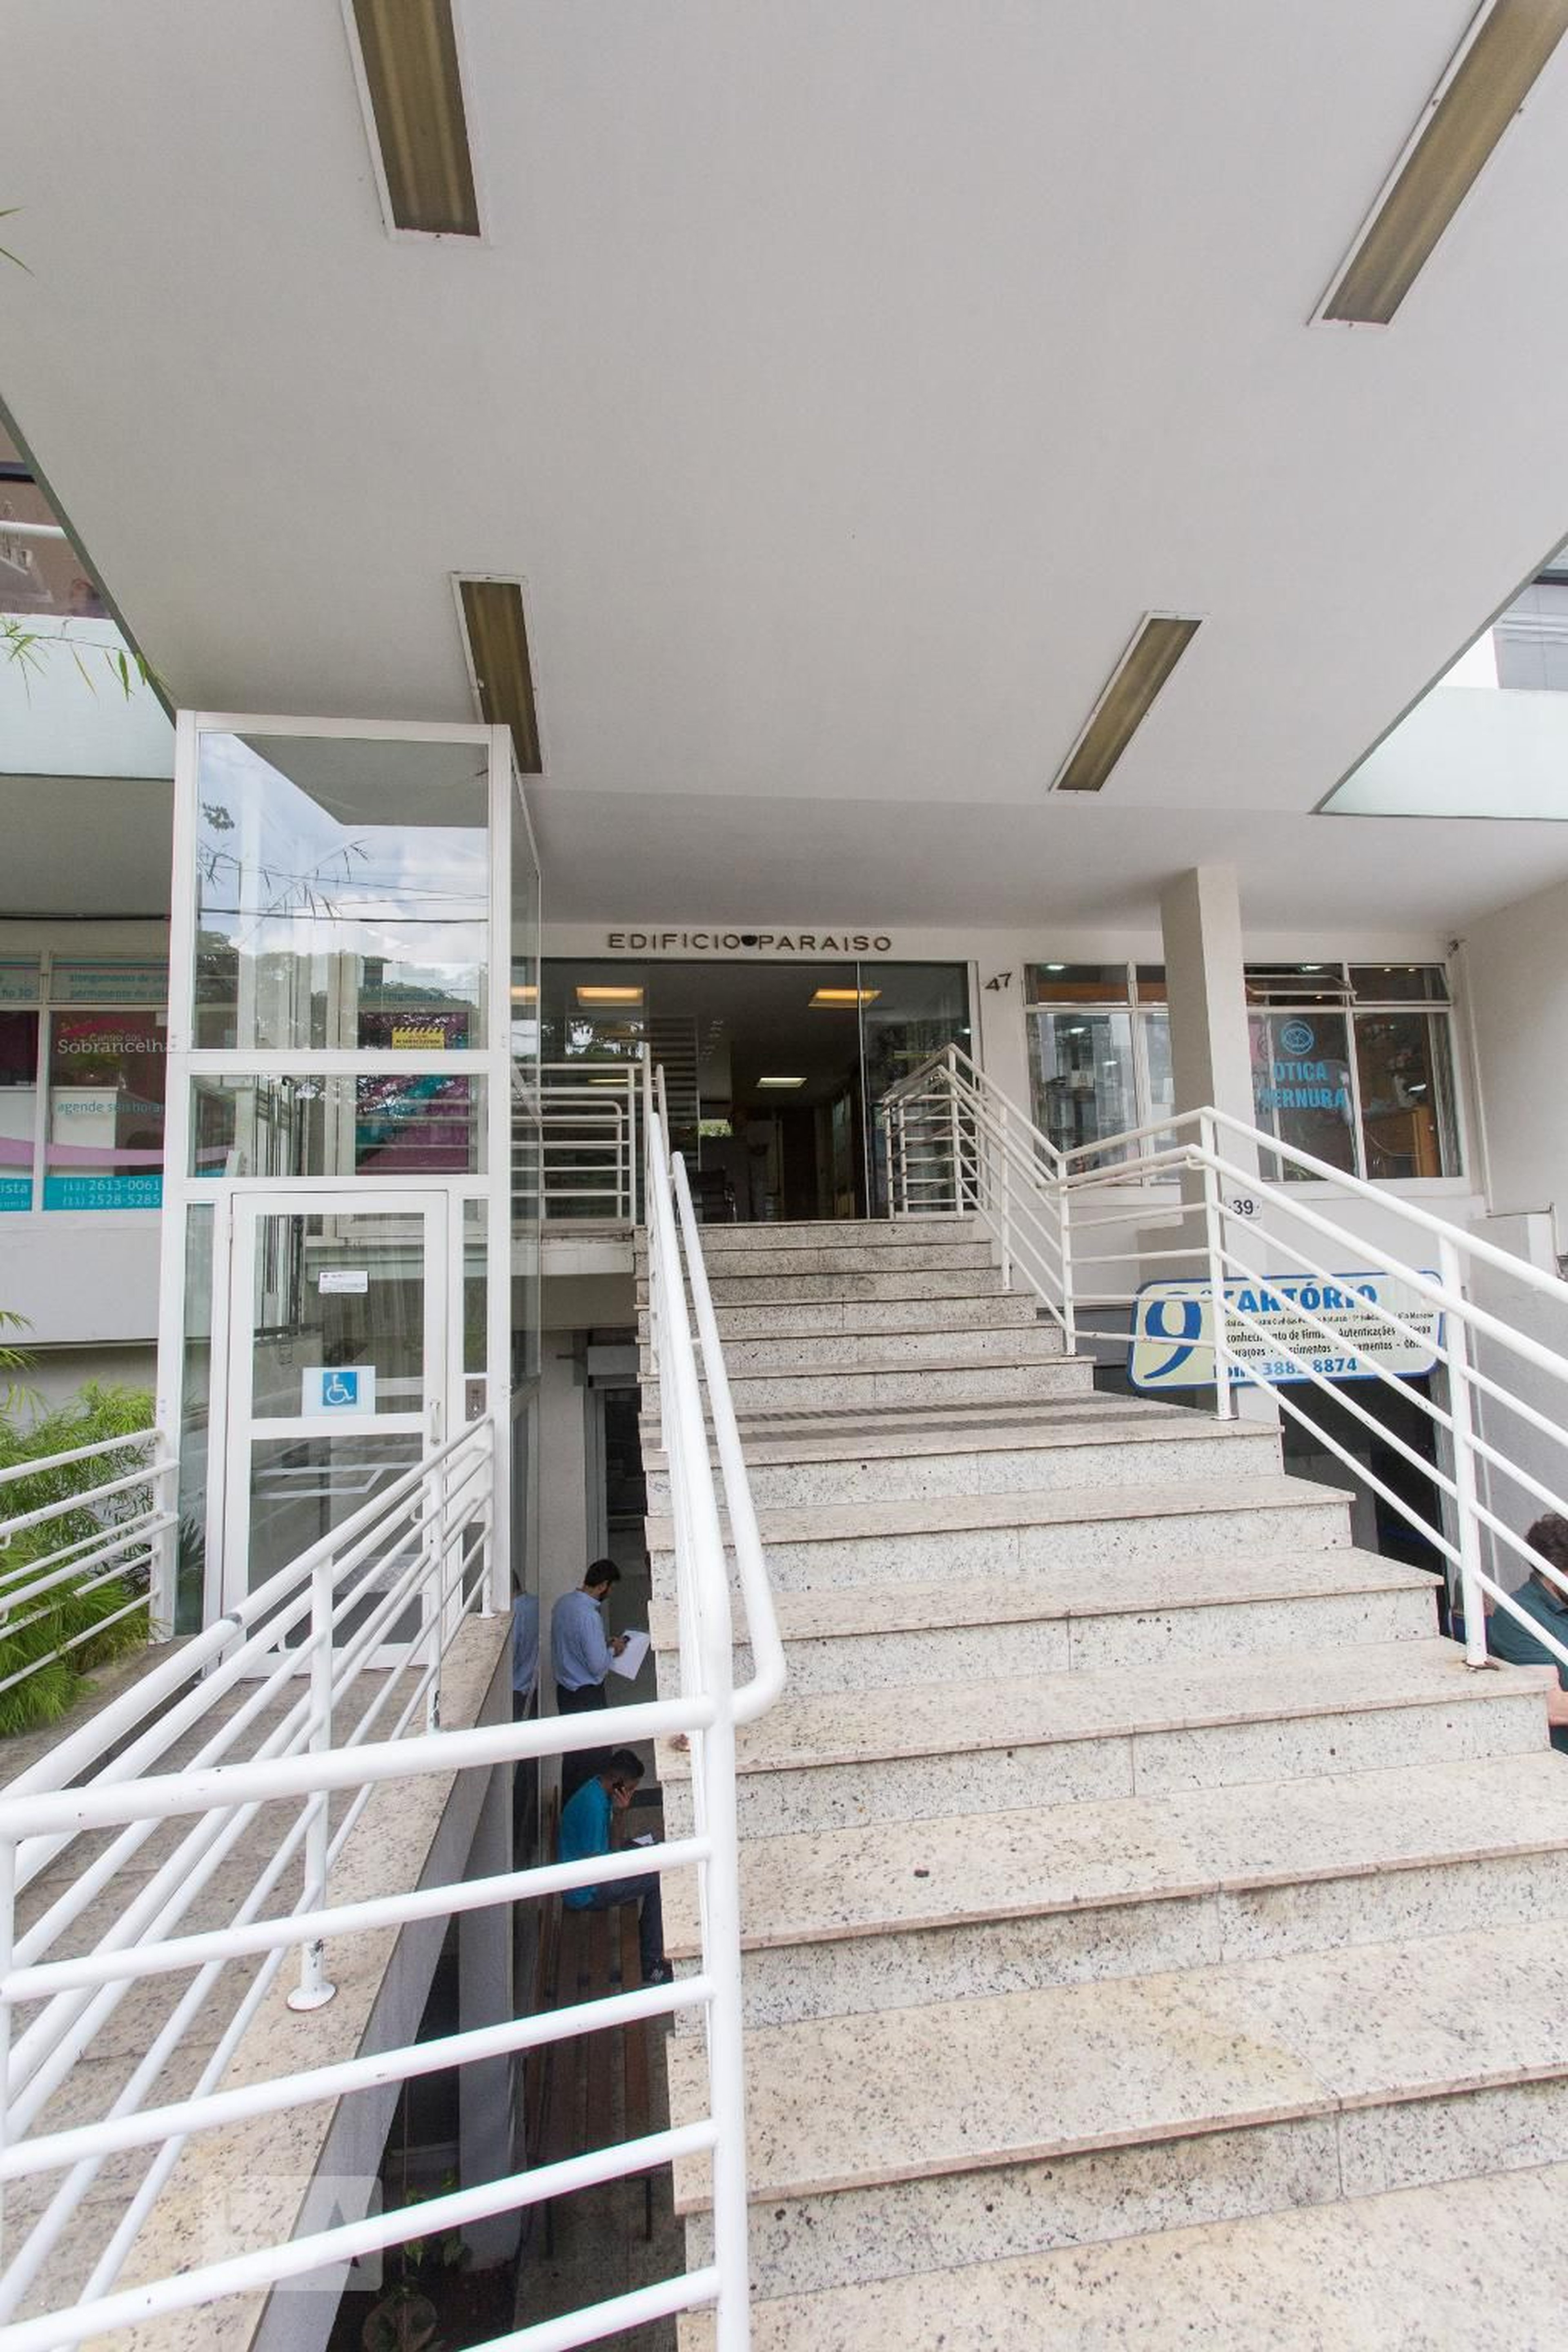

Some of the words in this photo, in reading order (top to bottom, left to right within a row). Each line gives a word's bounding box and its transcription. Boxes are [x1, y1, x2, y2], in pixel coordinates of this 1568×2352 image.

[609, 933, 740, 950] EDIFICIO
[758, 935, 891, 951] PARAISO
[984, 973, 1012, 991] 47
[89, 1179, 160, 1191] 2613-0061
[1233, 1200, 1253, 1215] 39
